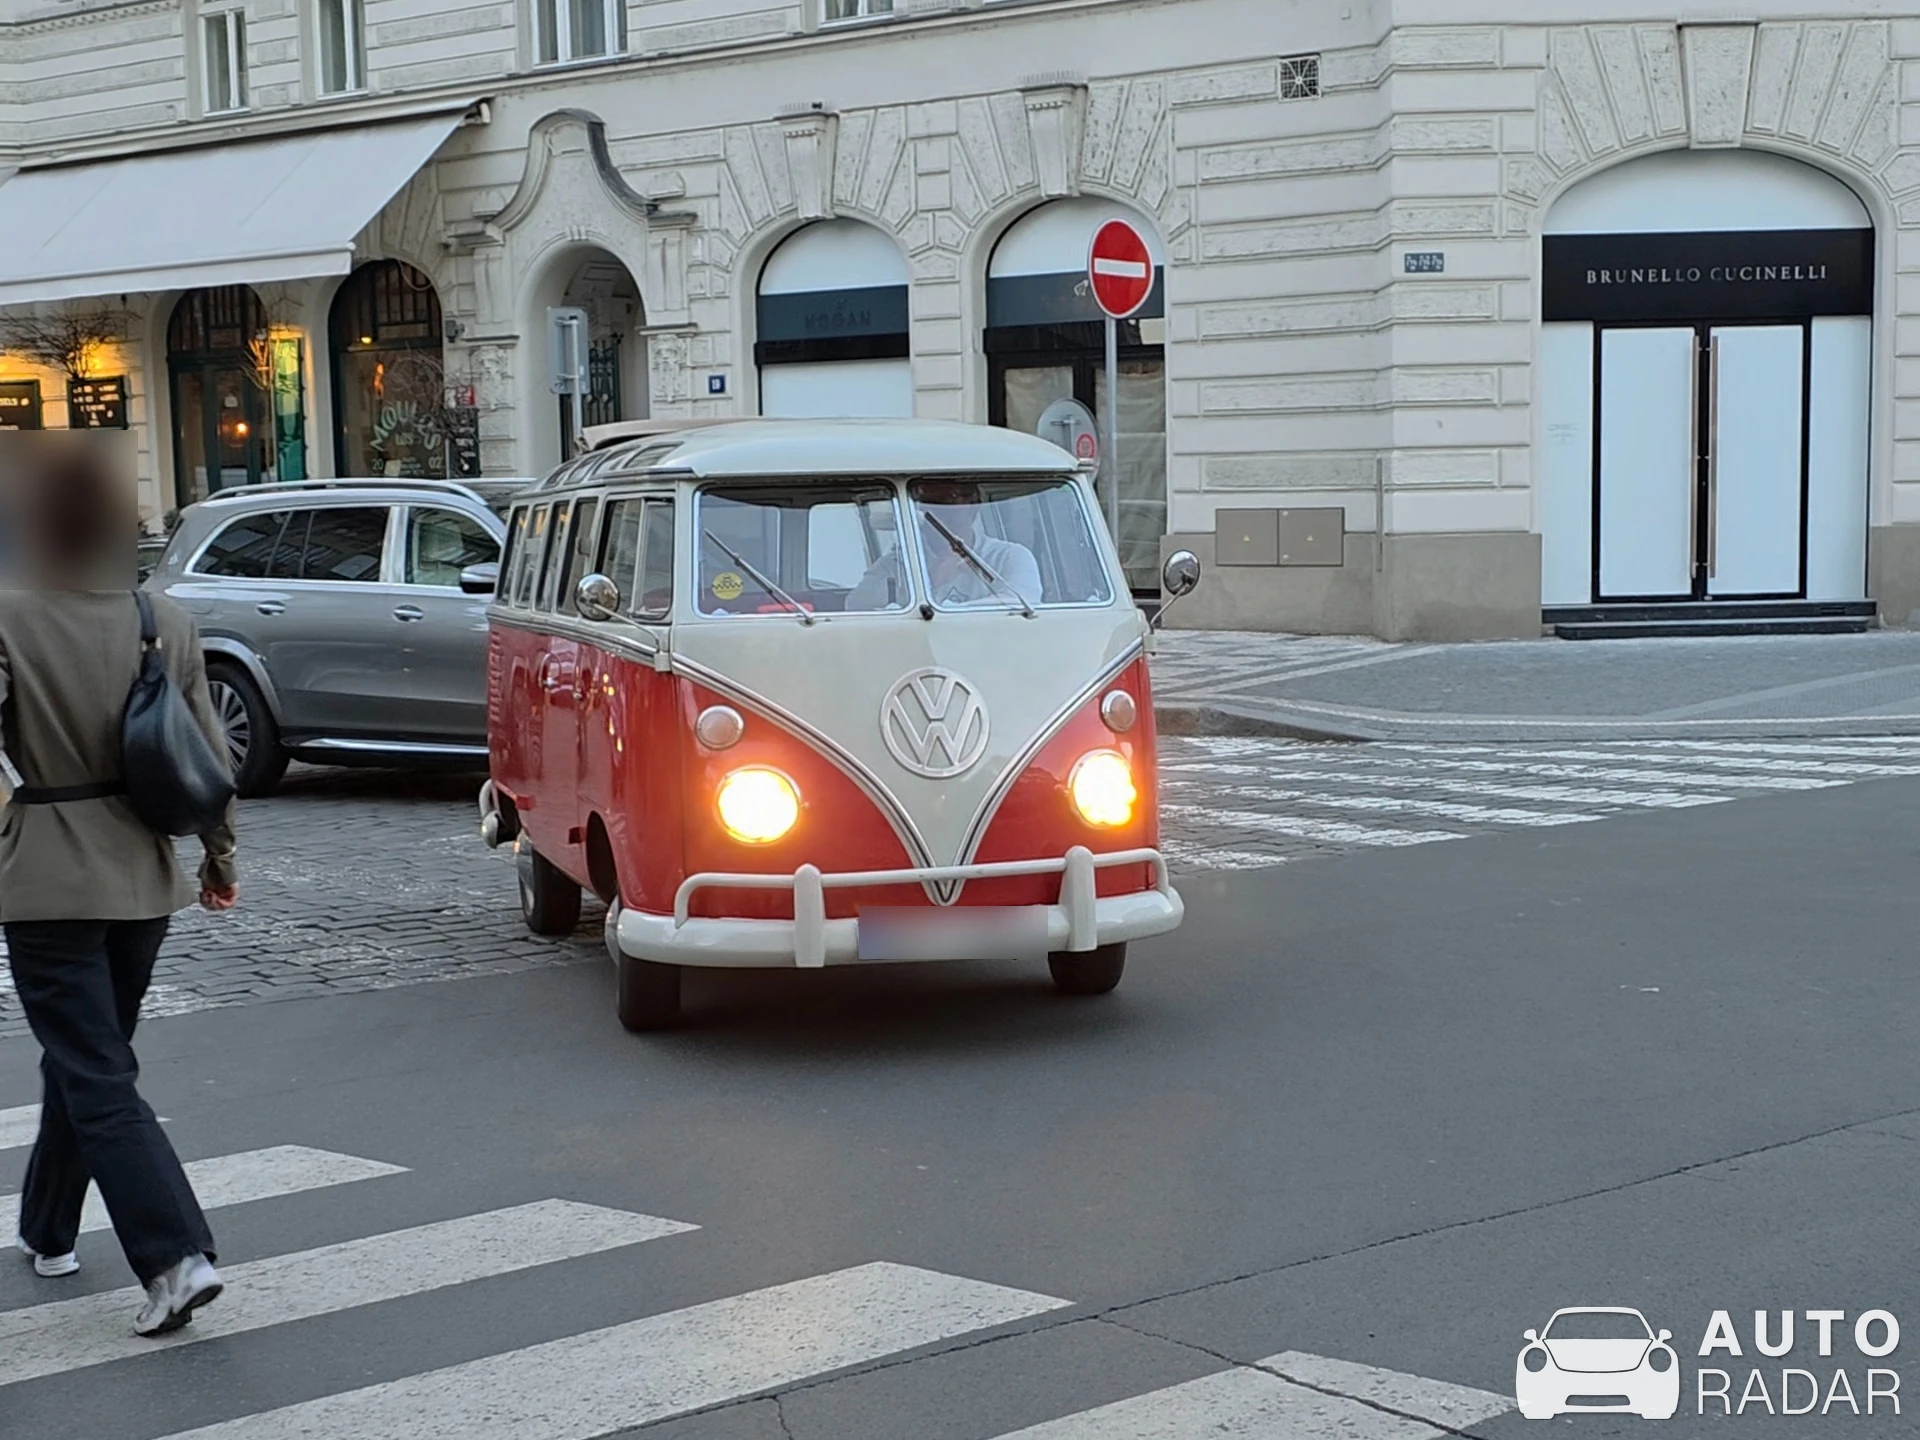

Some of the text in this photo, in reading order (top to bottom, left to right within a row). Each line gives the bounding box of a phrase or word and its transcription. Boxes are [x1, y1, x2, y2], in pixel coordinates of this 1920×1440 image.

[1586, 265, 1827, 284] BRUNELLO CUCINELLI
[885, 672, 984, 773] VW
